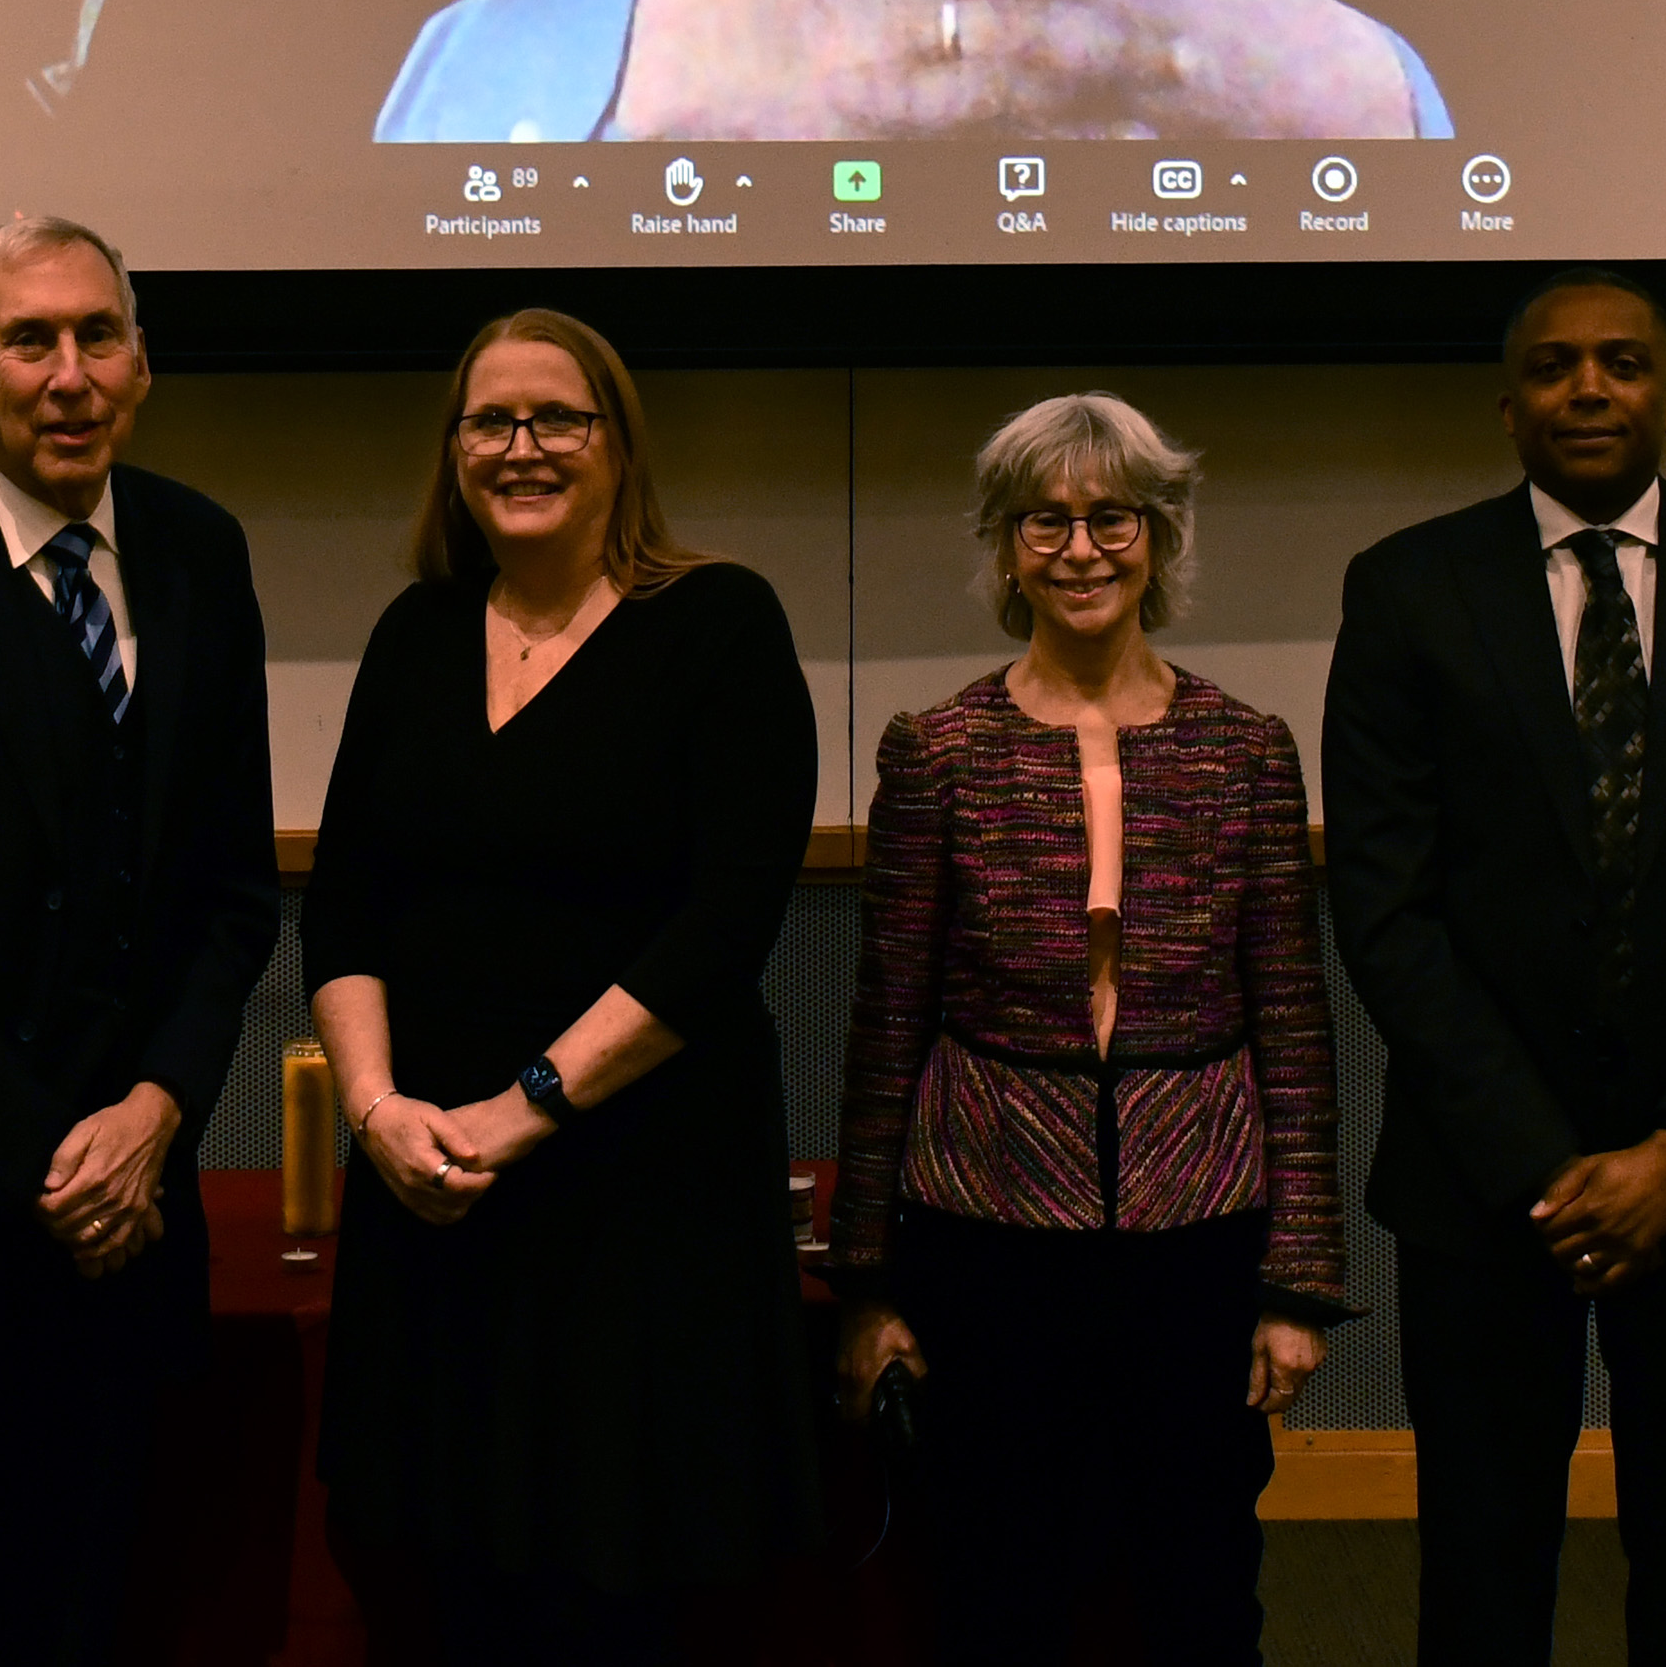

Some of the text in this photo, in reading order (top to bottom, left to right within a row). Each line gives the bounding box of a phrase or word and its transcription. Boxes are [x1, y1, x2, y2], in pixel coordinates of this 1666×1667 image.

[512, 168, 538, 188] 89
[425, 214, 541, 239] Participants
[631, 214, 738, 234] Raise hand
[829, 213, 886, 233] Share
[997, 212, 1047, 234] Q&A
[1111, 212, 1247, 236] Hide captions
[1300, 212, 1369, 232] Record
[1461, 212, 1514, 232] More
